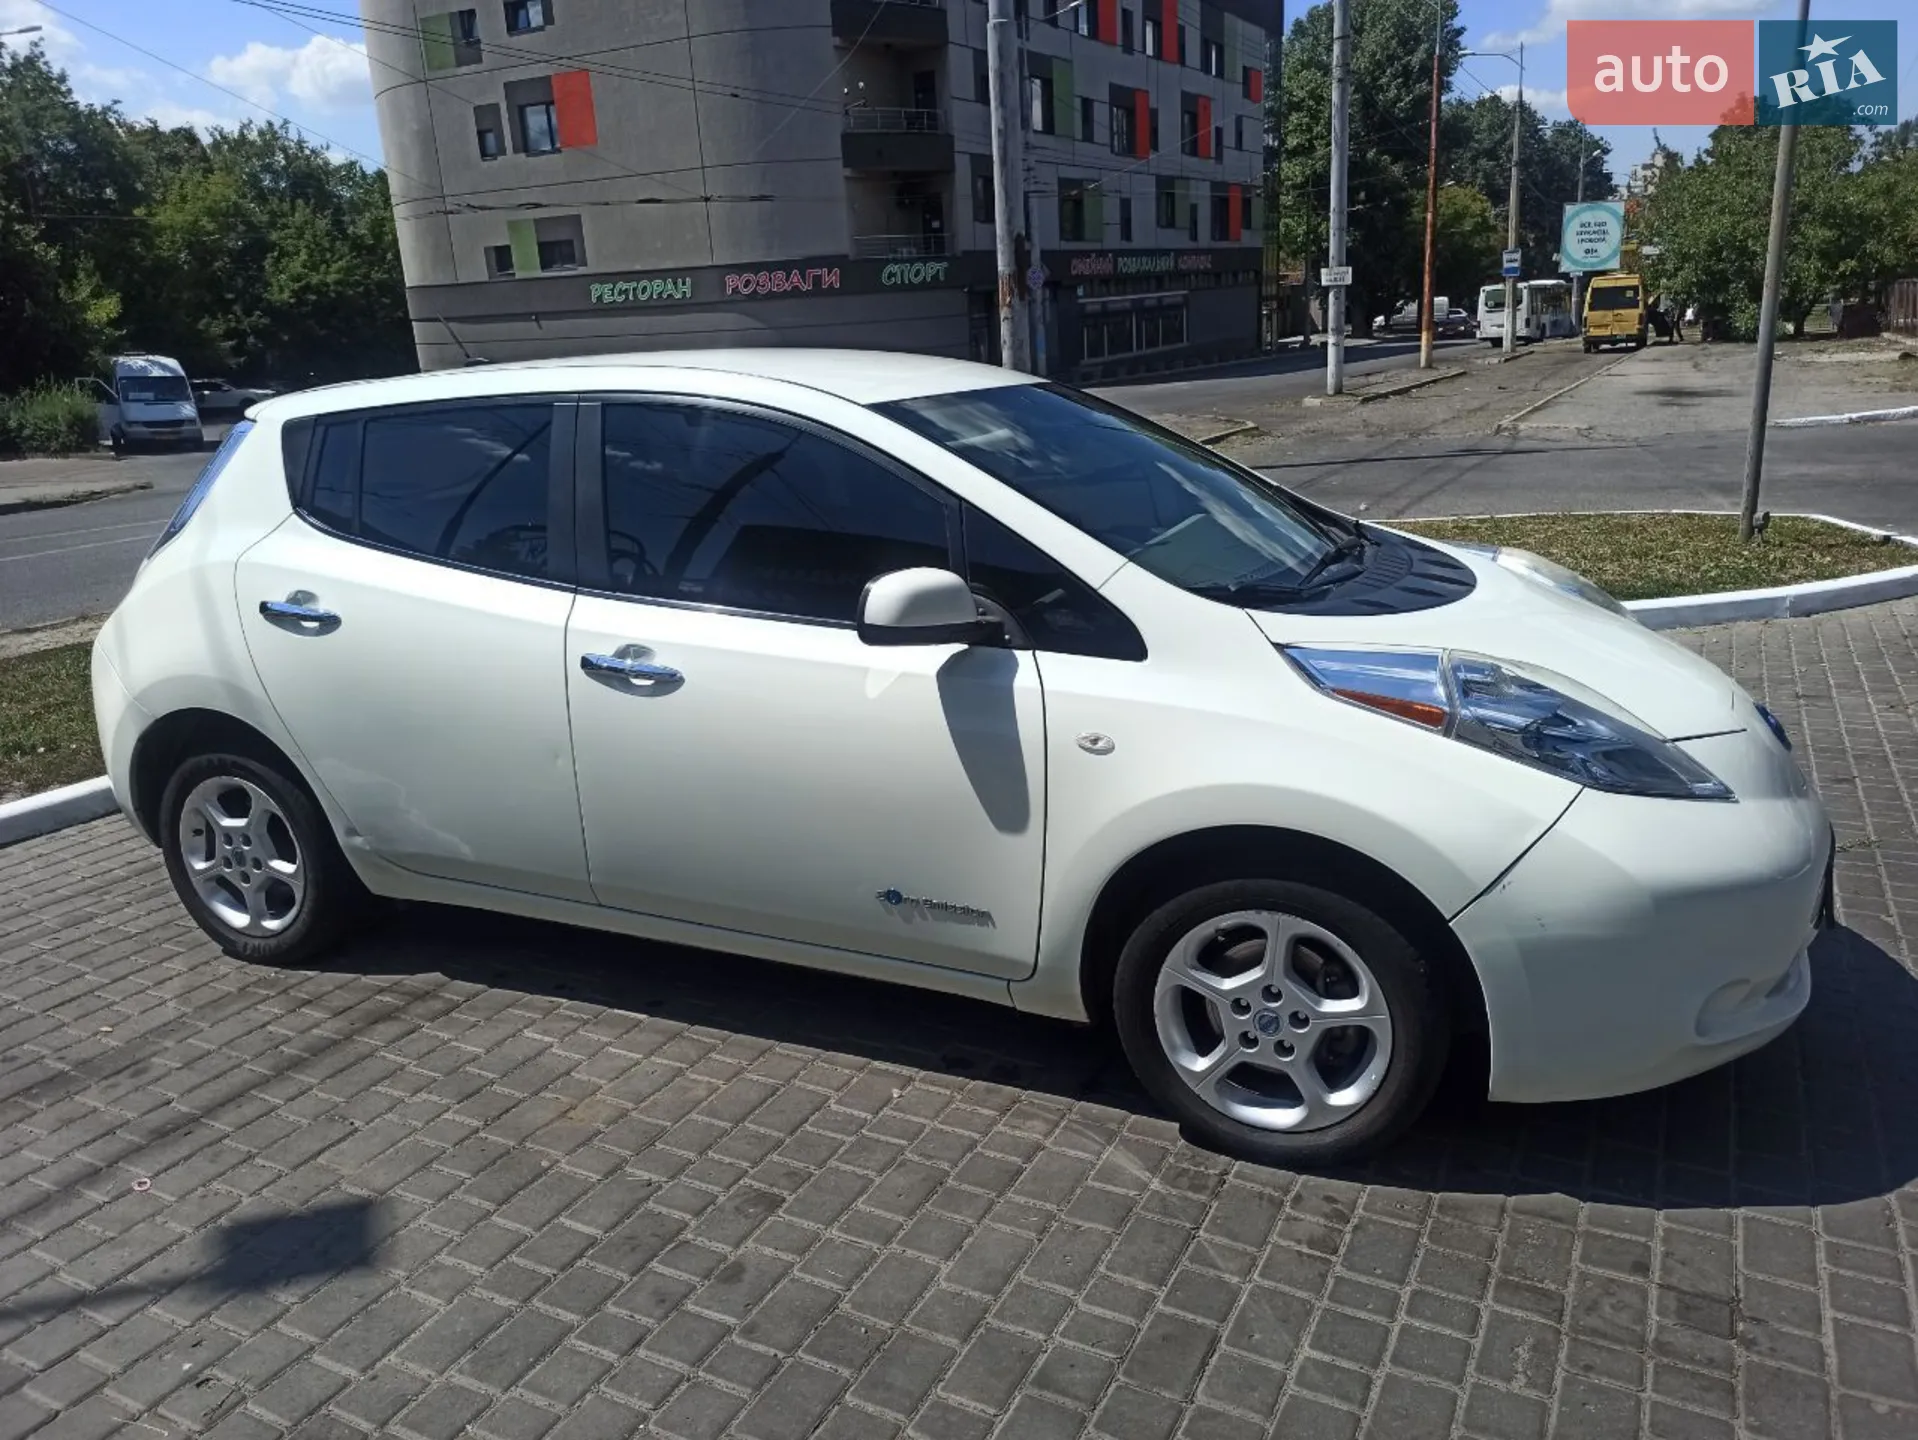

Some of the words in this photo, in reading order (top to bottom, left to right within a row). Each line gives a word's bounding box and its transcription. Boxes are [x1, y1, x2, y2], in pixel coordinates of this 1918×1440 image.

[589, 277, 692, 303] РЕСТОРАН
[725, 267, 840, 295] РОЗВАГИ
[881, 261, 949, 286] СПОРТ
